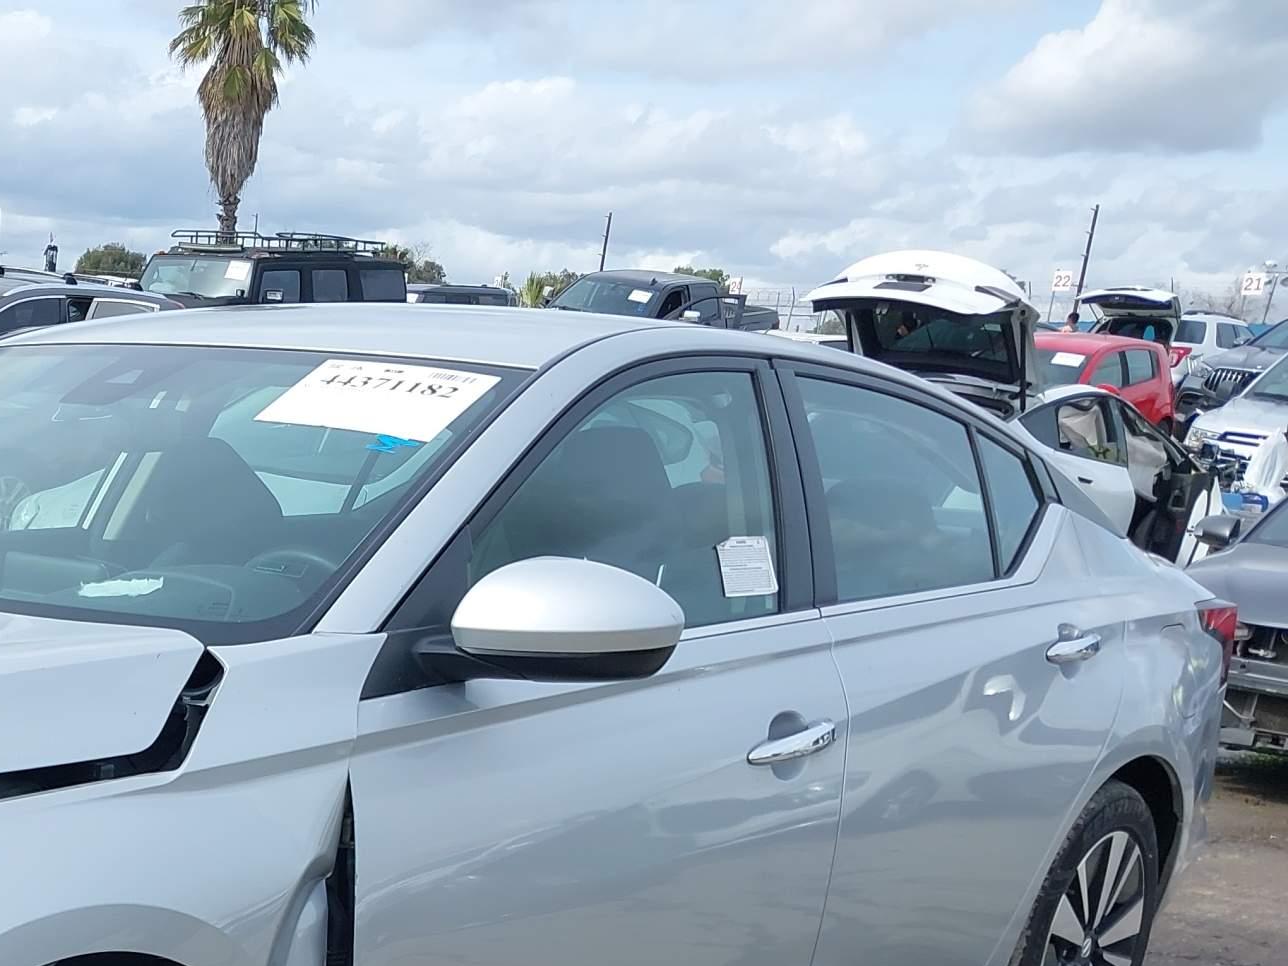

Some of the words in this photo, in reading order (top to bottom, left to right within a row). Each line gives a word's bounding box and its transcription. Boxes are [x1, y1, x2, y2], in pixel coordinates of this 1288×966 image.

[1054, 275, 1071, 287] 22
[1244, 277, 1261, 291] 21
[320, 374, 459, 398] 44371182
